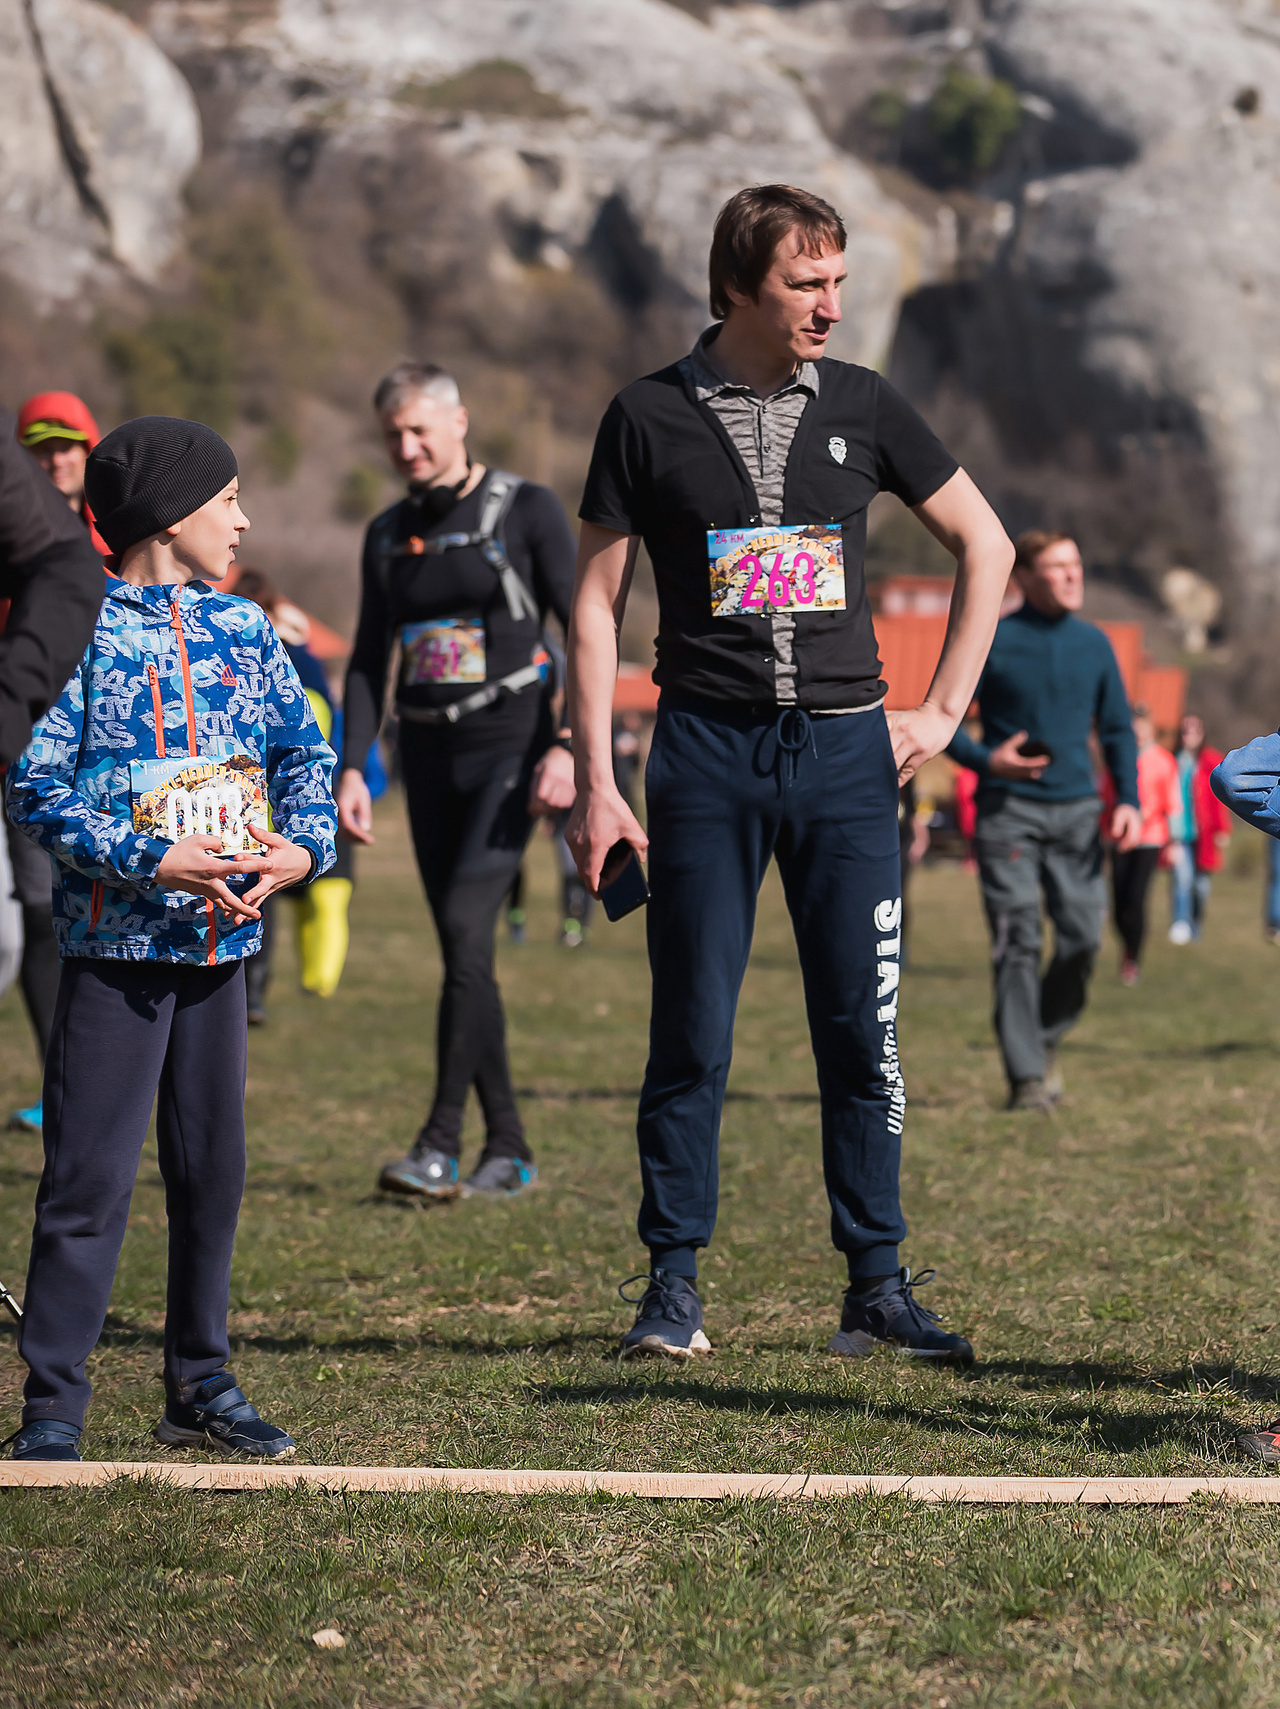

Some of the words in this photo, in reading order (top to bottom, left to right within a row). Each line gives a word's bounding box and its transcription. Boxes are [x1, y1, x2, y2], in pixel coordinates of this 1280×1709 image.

[714, 532, 727, 544] 24
[730, 533, 744, 543] KM
[722, 534, 799, 568] ESKI-KERMEN
[802, 538, 833, 564] TRAIL
[739, 552, 815, 608] 263
[143, 762, 148, 776] 1
[153, 765, 170, 775] KM
[148, 764, 226, 804] ESKI-KERMEN
[230, 769, 257, 798] TRAIL
[874, 898, 902, 1022] STAY
